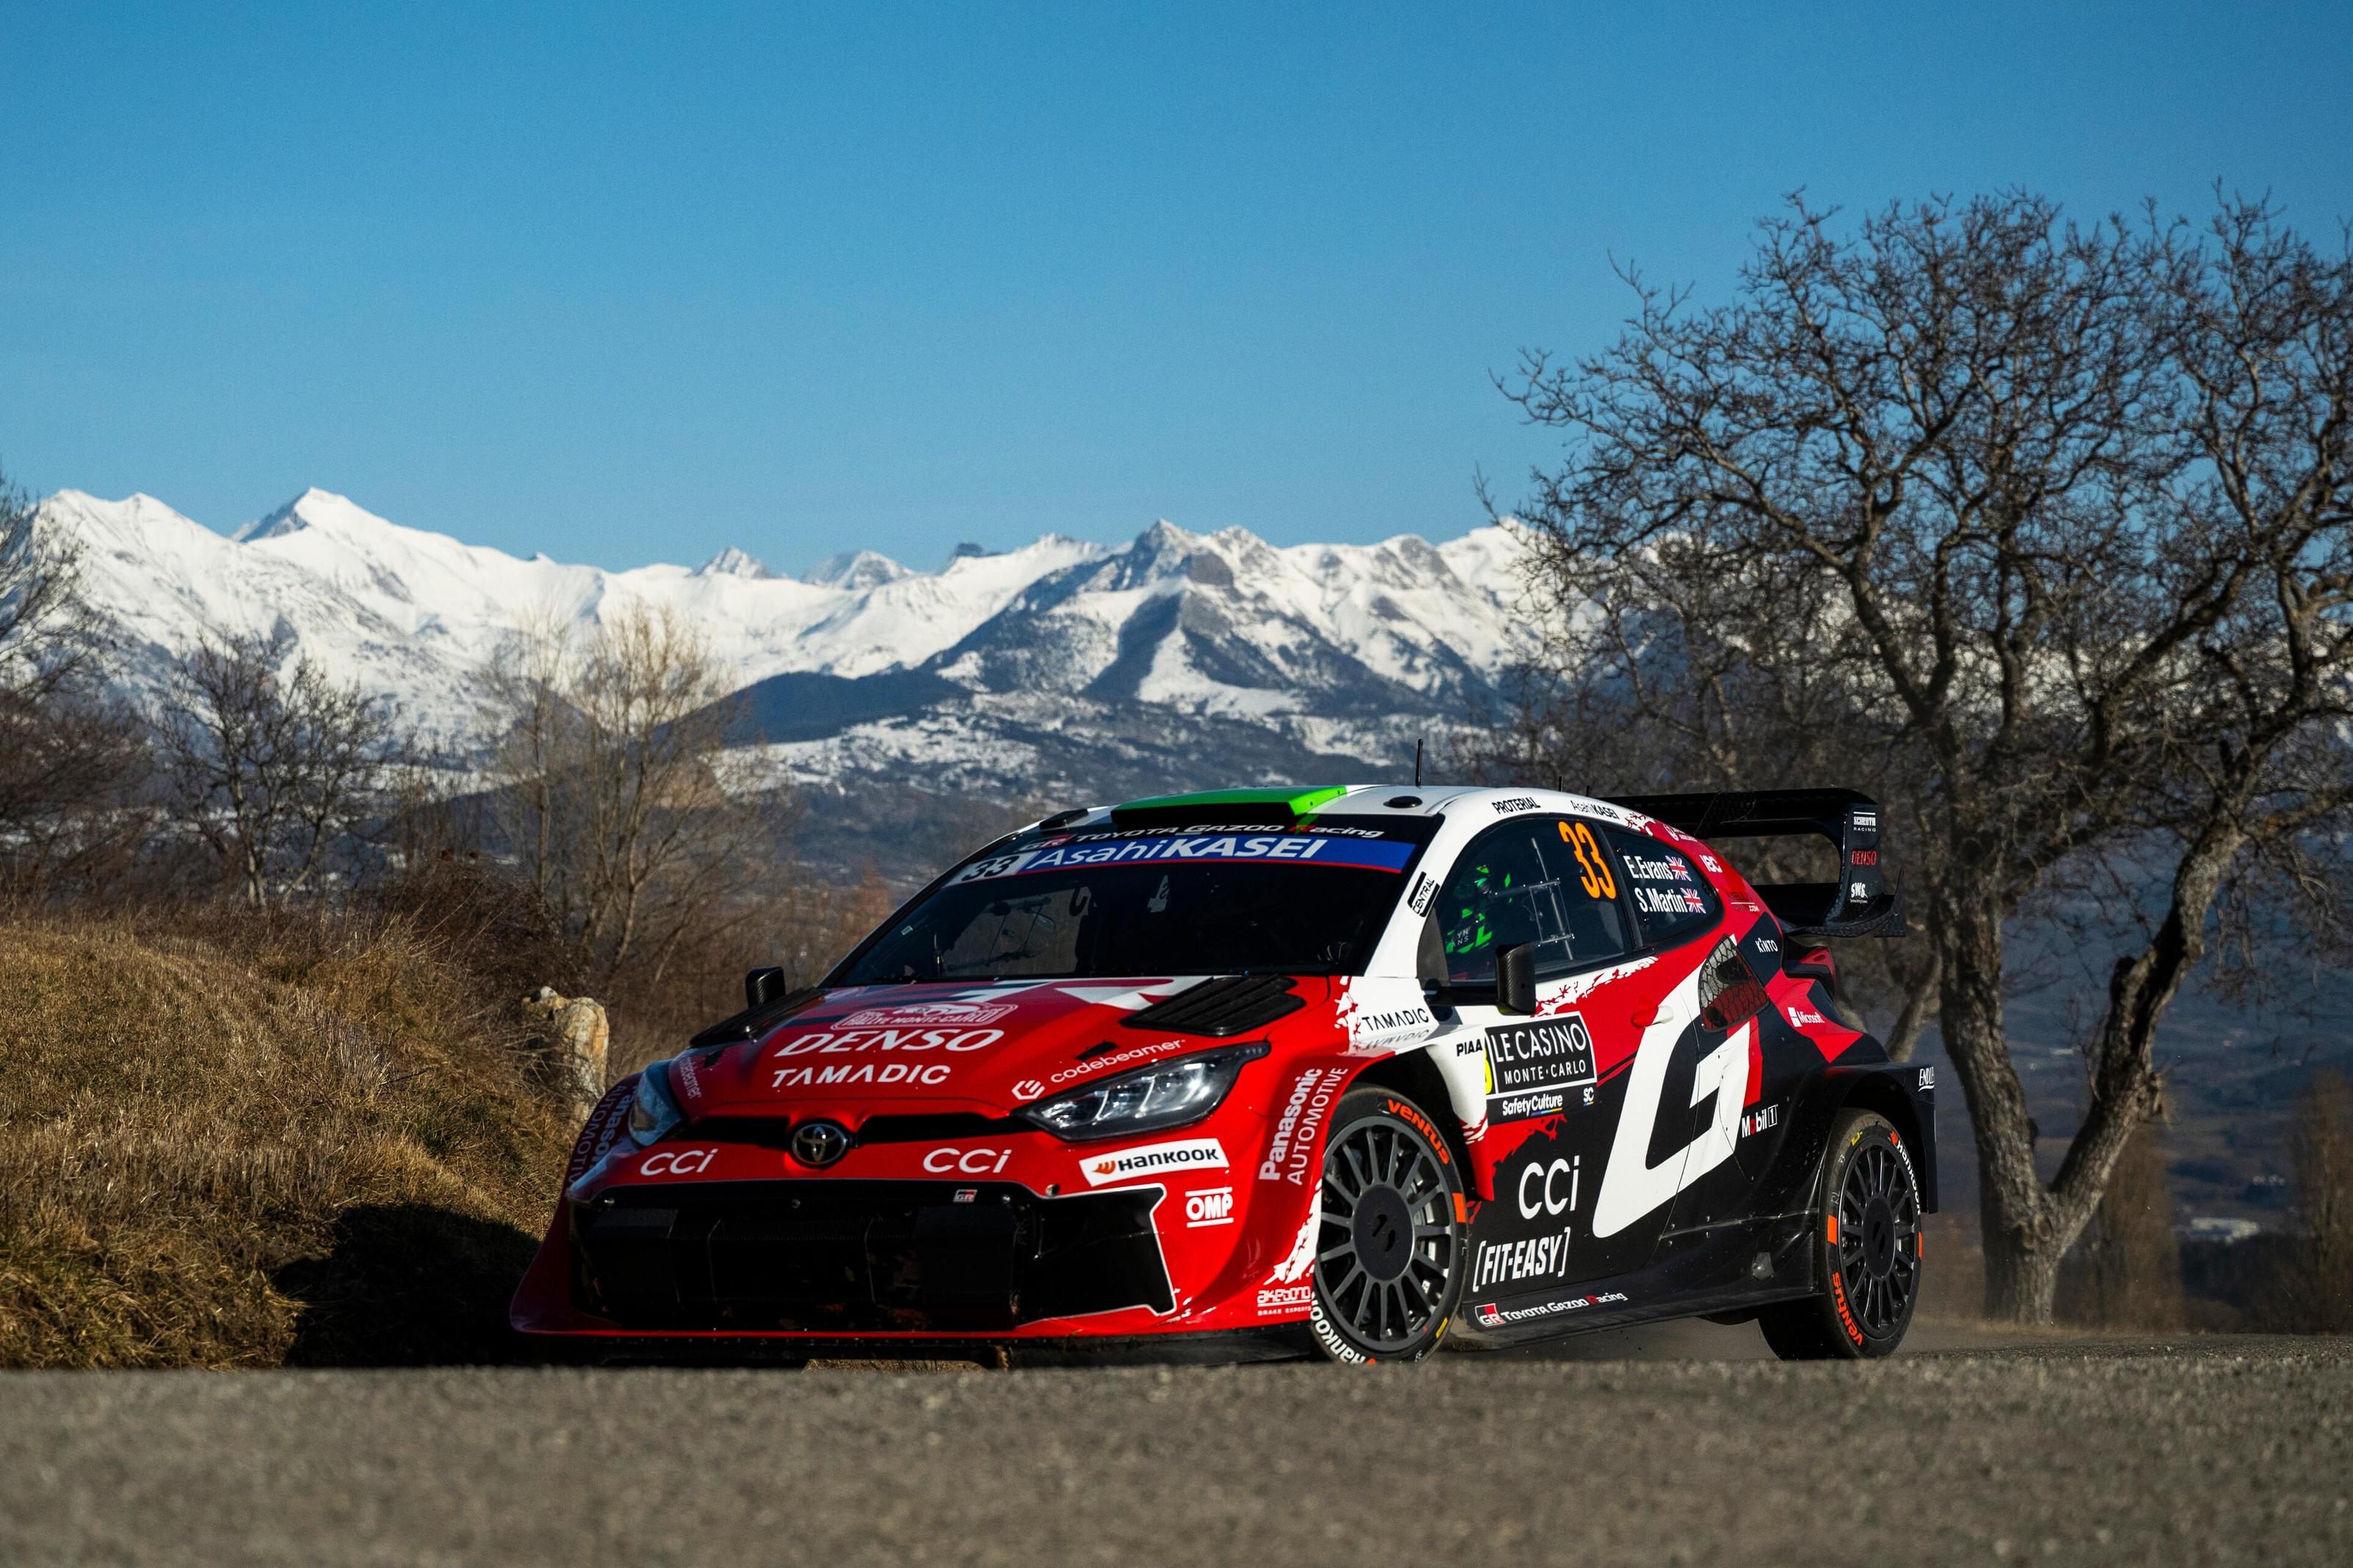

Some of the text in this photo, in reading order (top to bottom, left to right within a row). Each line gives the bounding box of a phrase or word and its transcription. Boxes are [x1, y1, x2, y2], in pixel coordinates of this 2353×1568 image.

[1491, 797, 1541, 814] PROTERIAL
[1076, 826, 1179, 842] TOYOTA
[1183, 824, 1285, 834] GAZOO
[1288, 825, 1385, 838] Racing
[961, 853, 1021, 881] 33
[1557, 820, 1616, 899] 33
[1623, 855, 1674, 881] E.Evans
[1851, 851, 1877, 865] DENSO
[1412, 878, 1435, 915] CENTRAL
[1635, 887, 1688, 914] S.Martin
[1851, 882, 1867, 898] SWS
[1361, 1008, 1429, 1031] TAMADIC
[774, 1029, 1005, 1058] DENSO
[1456, 1039, 1483, 1057] PIAA
[1490, 1023, 1587, 1062] LE CASINO
[1050, 1039, 1182, 1084] codebeamer
[772, 1064, 951, 1088] TAMADIC
[1502, 1093, 1563, 1117] SafetyCulture
[1583, 1086, 1595, 1103] SC
[568, 1085, 626, 1184] AUTOMOTIV
[1258, 1067, 1323, 1181] Panasonic
[1287, 1067, 1349, 1186] AUTOMOTIVE
[1741, 1108, 1768, 1138] Mobil
[1185, 1192, 1234, 1220] OMP
[1257, 1286, 1311, 1303] akebono
[1257, 1309, 1282, 1317] BRAKE
[1477, 1292, 1629, 1326] GR TOYOTA GAZOO Racing
